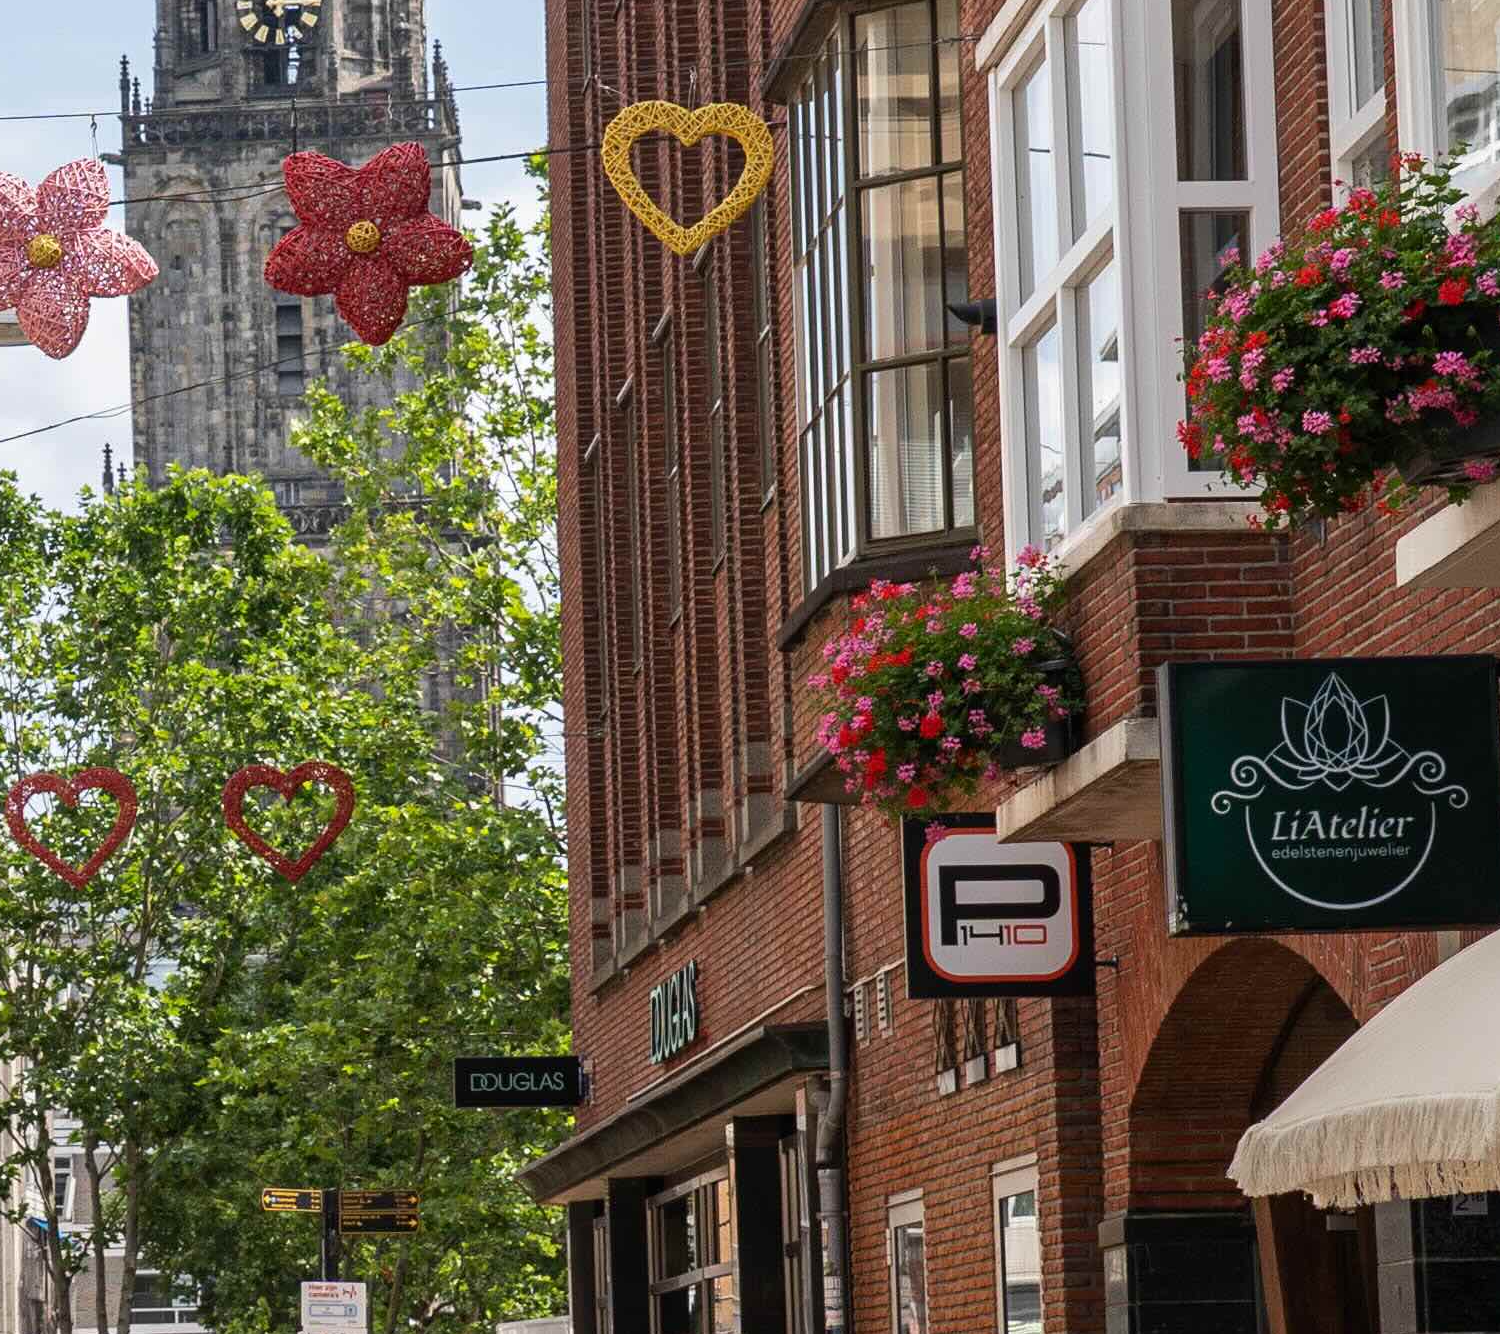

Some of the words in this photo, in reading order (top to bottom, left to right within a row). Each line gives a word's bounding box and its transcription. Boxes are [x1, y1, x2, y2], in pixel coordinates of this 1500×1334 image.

[1271, 805, 1415, 841] LiAtelier
[1271, 843, 1411, 862] edelstenenjuwelier
[651, 959, 696, 1065] DOUGLAS
[470, 1071, 565, 1092] DOUGLAS
